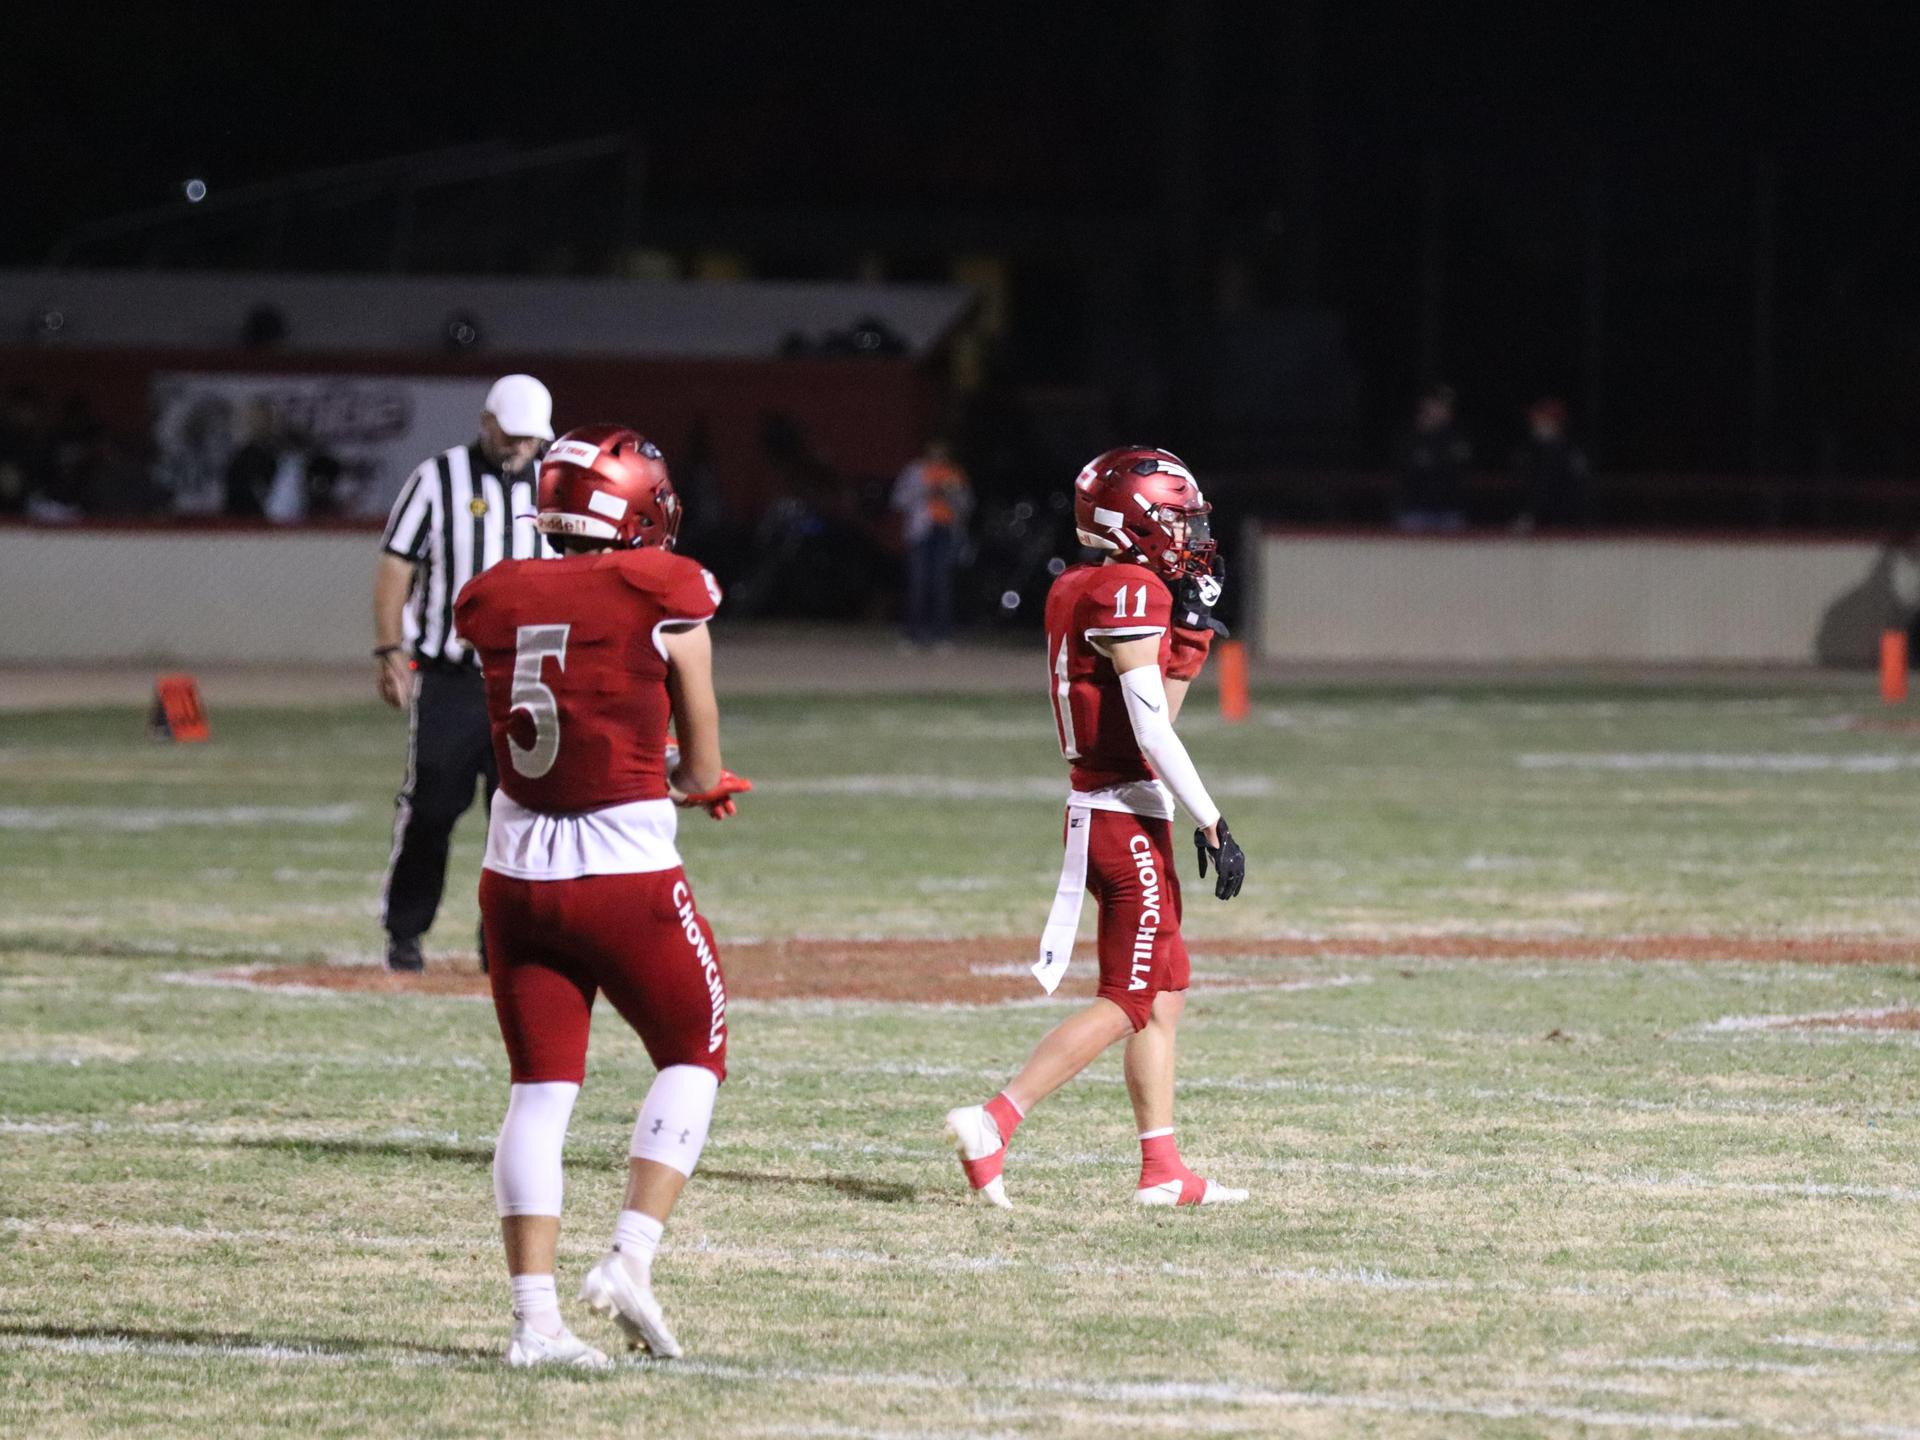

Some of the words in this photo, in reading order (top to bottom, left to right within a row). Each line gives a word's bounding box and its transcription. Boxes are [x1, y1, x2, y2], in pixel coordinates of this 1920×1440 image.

[1113, 584, 1147, 618] 11
[506, 624, 571, 779] 5
[1047, 631, 1082, 760] 1
[672, 880, 726, 1054] CHOWCHILLA
[1127, 834, 1160, 992] CHOWCHILLA
